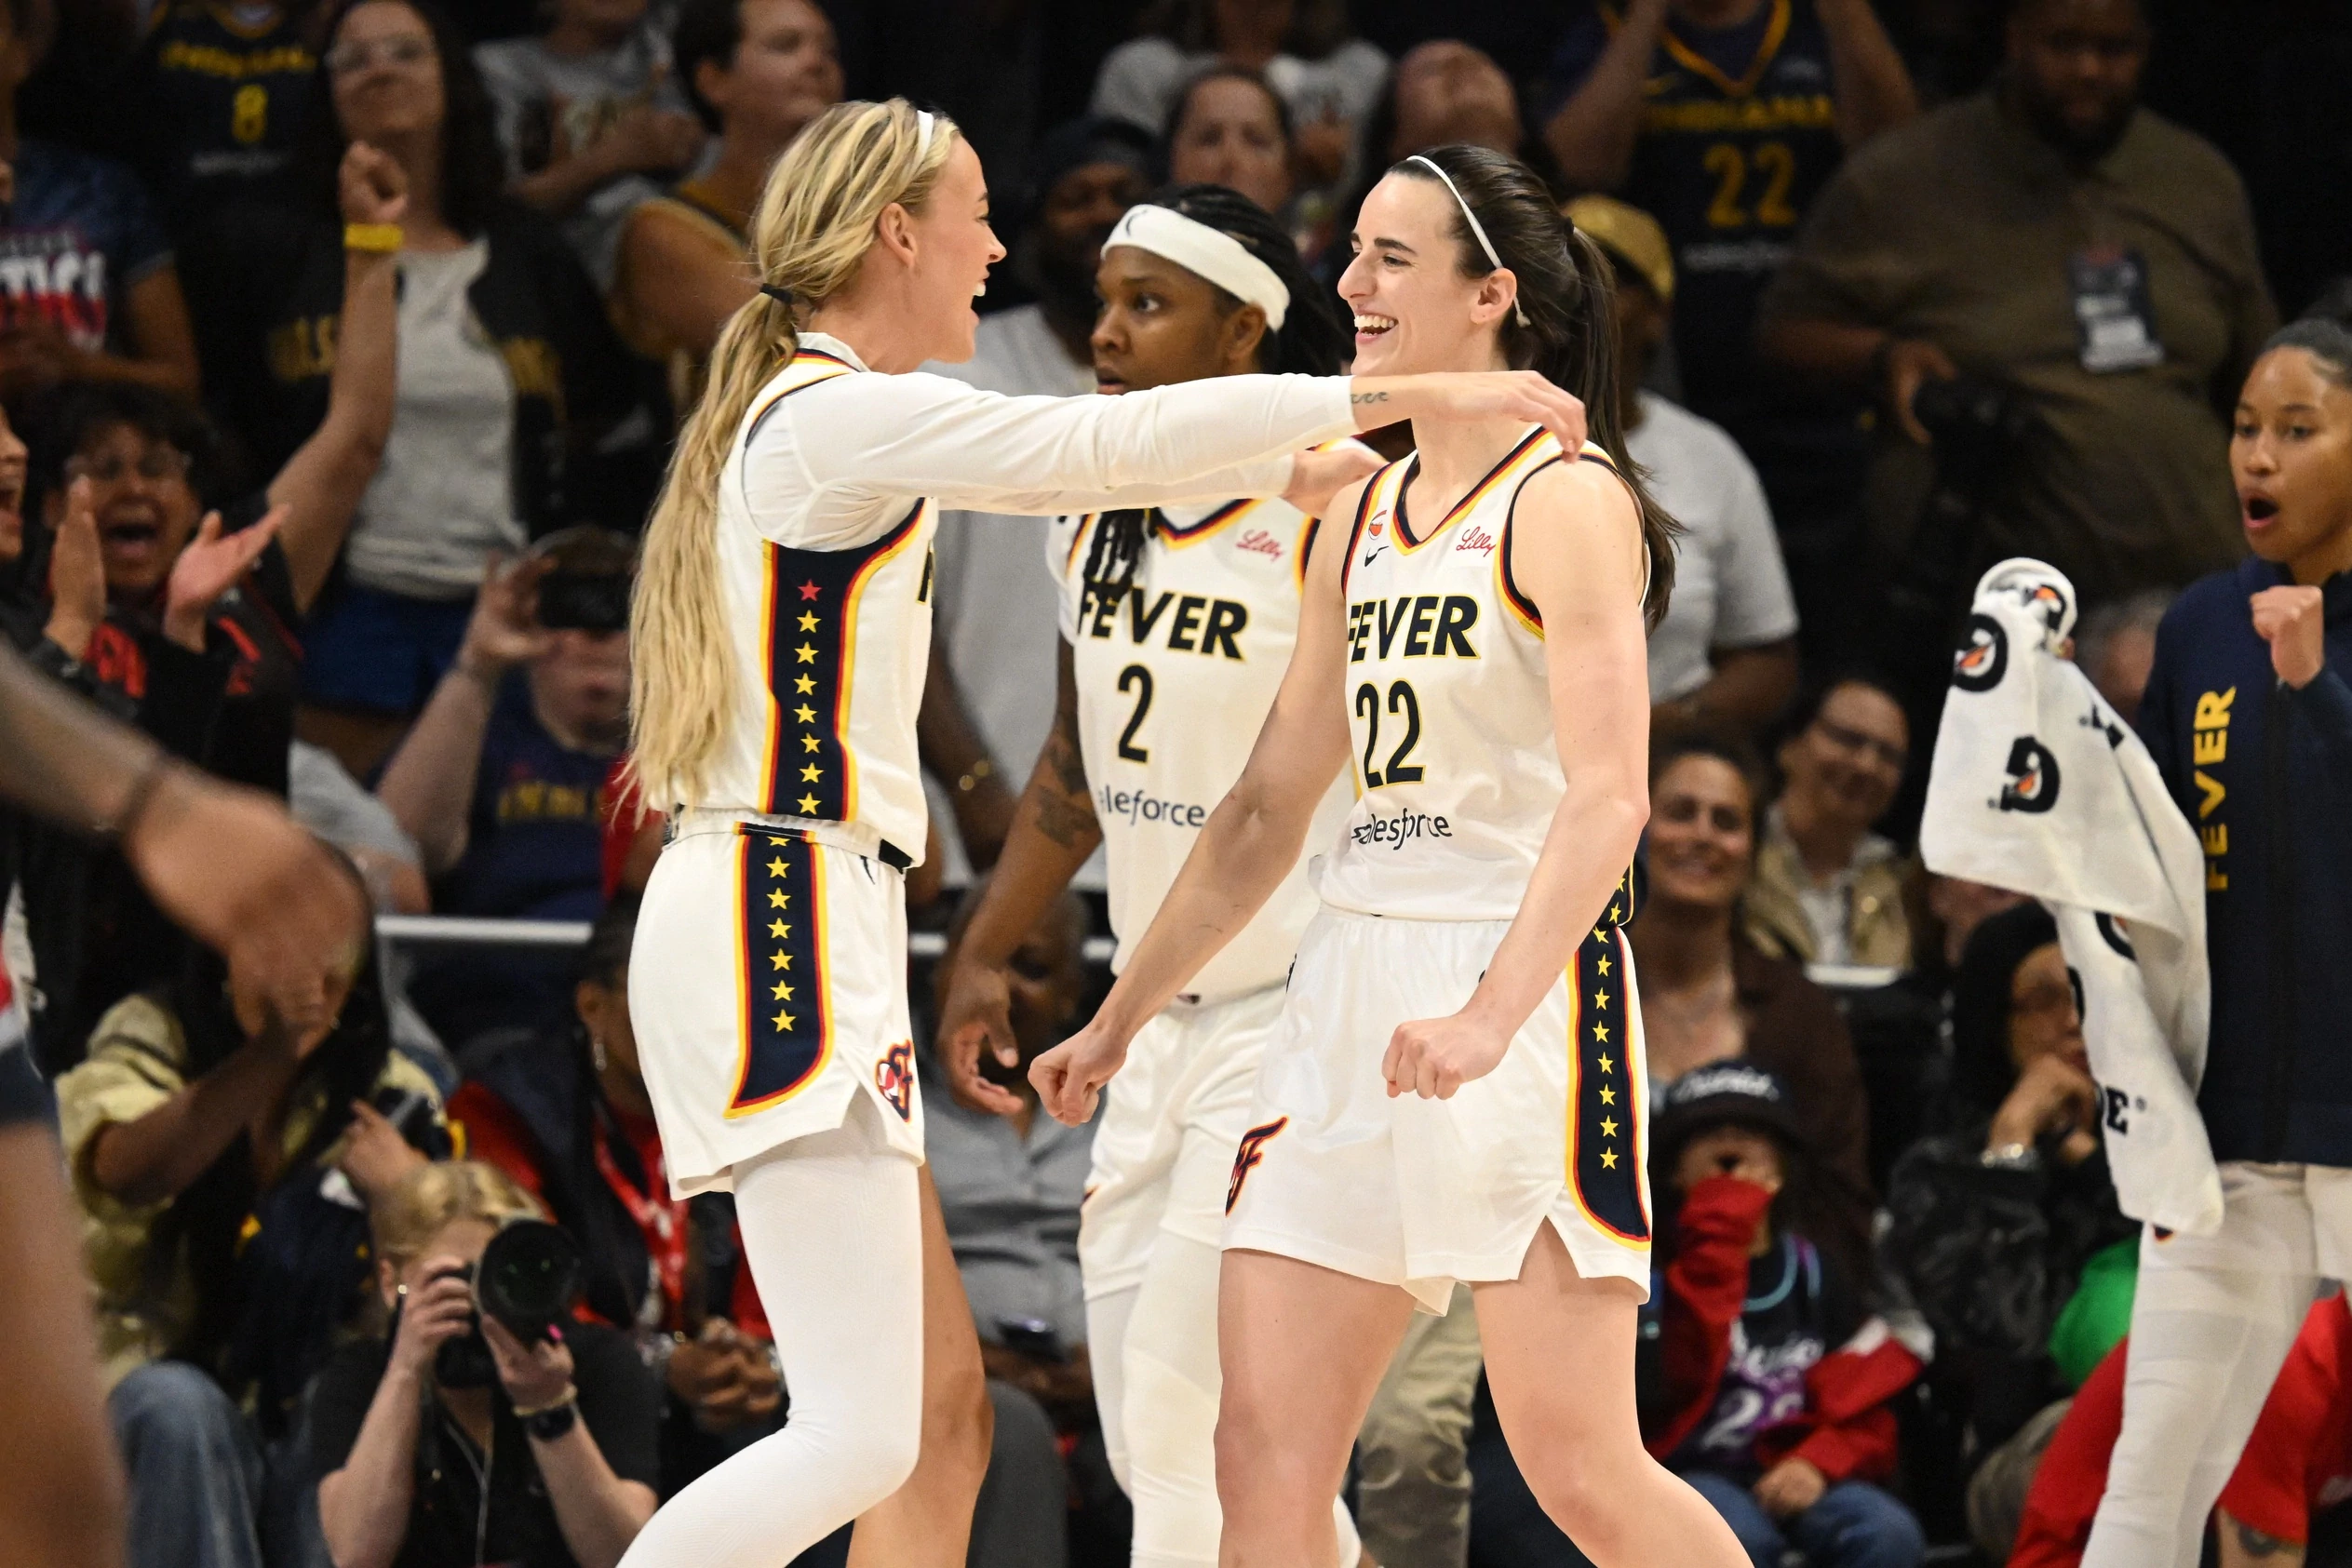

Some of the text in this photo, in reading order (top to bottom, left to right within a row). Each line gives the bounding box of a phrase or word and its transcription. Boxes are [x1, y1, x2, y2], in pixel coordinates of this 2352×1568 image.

[1703, 142, 1796, 227] 22
[1235, 529, 1284, 562] Lilly
[1456, 526, 1496, 557] Lilly
[1117, 663, 1156, 765] 2
[1355, 678, 1426, 791] 22
[2193, 685, 2237, 891] FEVER
